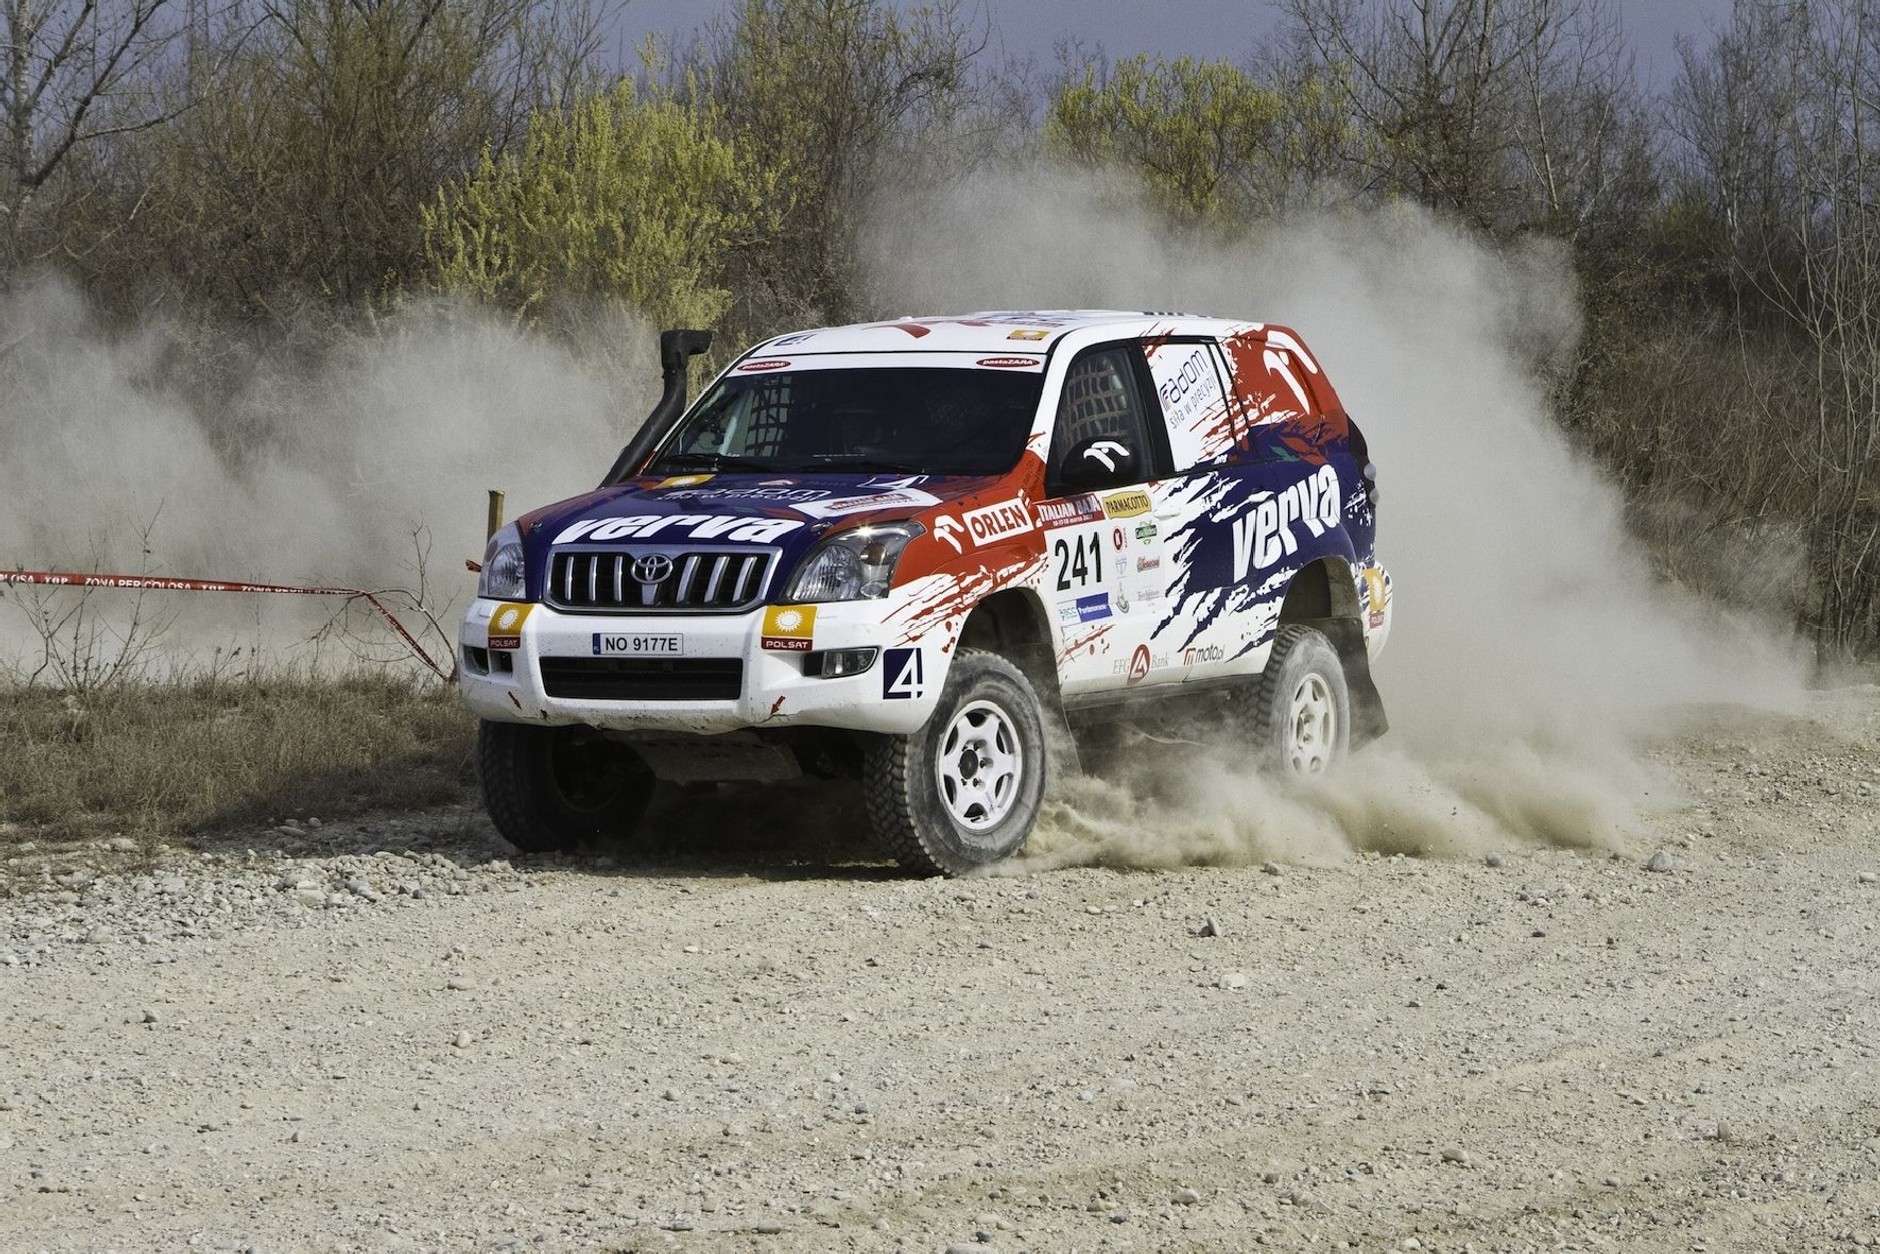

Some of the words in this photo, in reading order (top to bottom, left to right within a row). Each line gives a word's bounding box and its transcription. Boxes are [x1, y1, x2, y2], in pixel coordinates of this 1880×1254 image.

[1035, 502, 1077, 522] ITALIAN
[1105, 494, 1149, 514] PARMACOTTO
[551, 514, 806, 545] verva
[970, 504, 1029, 539] ORLEN
[1232, 464, 1341, 583] verva
[1054, 531, 1102, 591] 241
[605, 637, 628, 651] NO
[633, 637, 678, 651] 9177E
[765, 640, 809, 649] POLSAT
[1113, 658, 1131, 675] EFG
[1151, 651, 1170, 668] Bank
